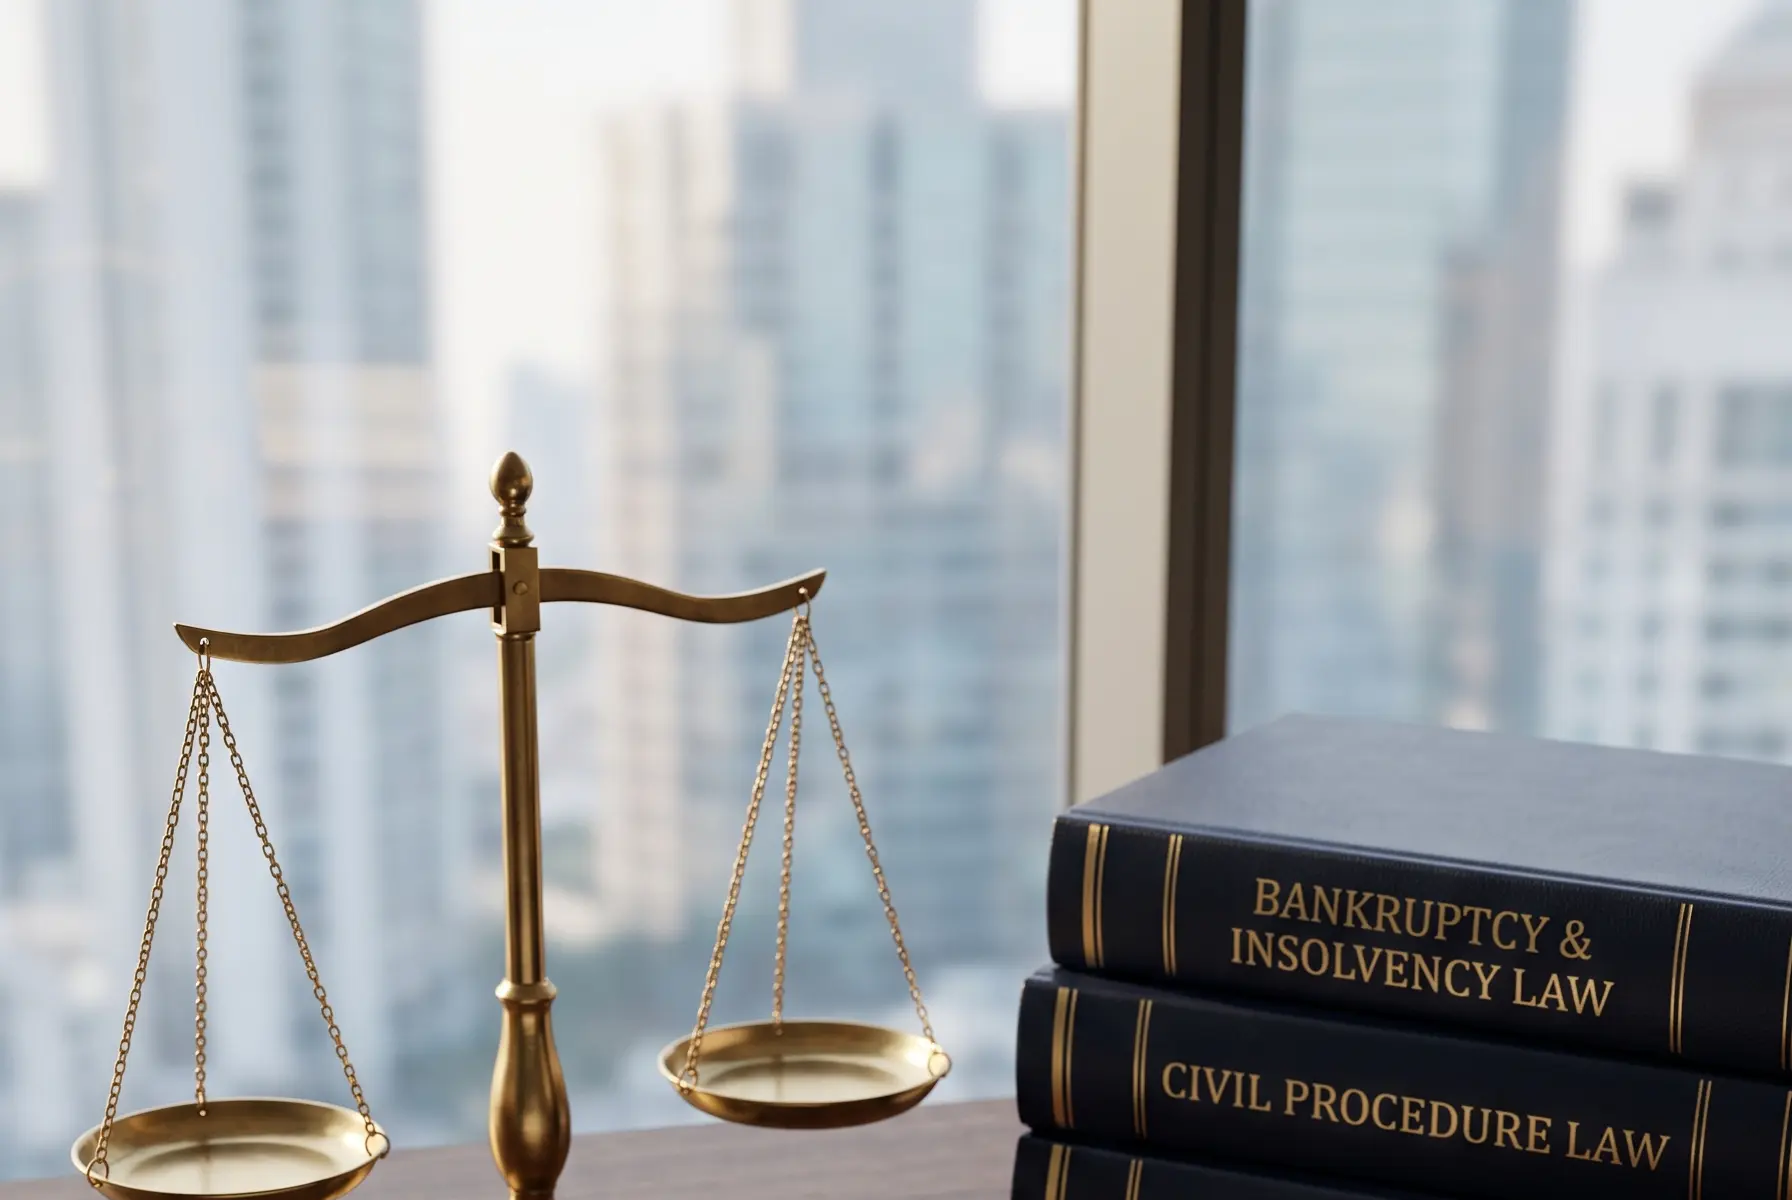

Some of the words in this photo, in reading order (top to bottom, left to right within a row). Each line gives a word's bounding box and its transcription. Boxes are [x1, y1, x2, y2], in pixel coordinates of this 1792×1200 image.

[1254, 877, 1550, 954] BANKRUPTCY
[1559, 919, 1592, 961] &
[1232, 927, 1501, 1001] INSOLVENCY
[1513, 967, 1614, 1017] LAW
[1161, 1061, 1272, 1113] CIVIL
[1285, 1079, 1552, 1154] PROCEDURE
[1566, 1120, 1670, 1171] LAW
